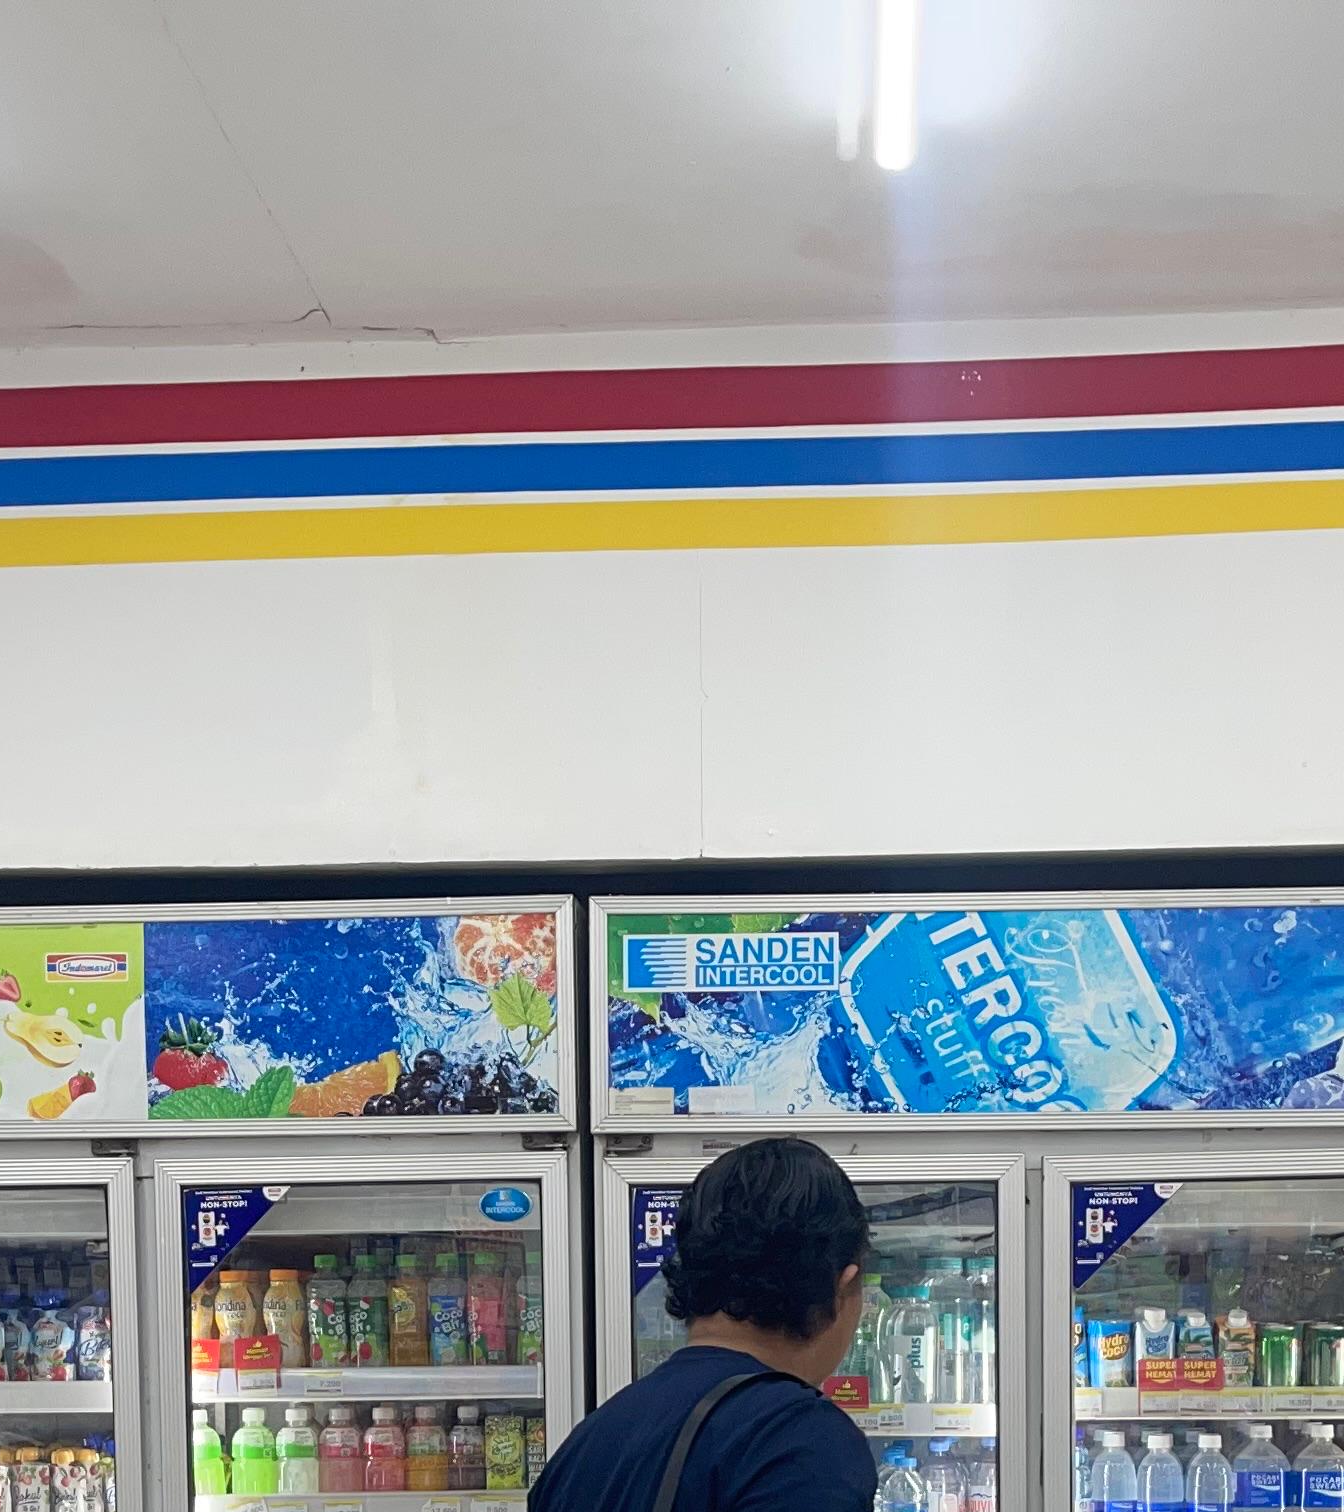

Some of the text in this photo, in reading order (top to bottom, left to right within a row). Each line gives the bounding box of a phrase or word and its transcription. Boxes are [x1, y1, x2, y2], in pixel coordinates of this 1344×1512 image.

[695, 938, 835, 963] SANDEN
[698, 965, 831, 986] INTERCOOL
[648, 1201, 680, 1209] NON-ST
[1184, 1361, 1217, 1369] SUPER
